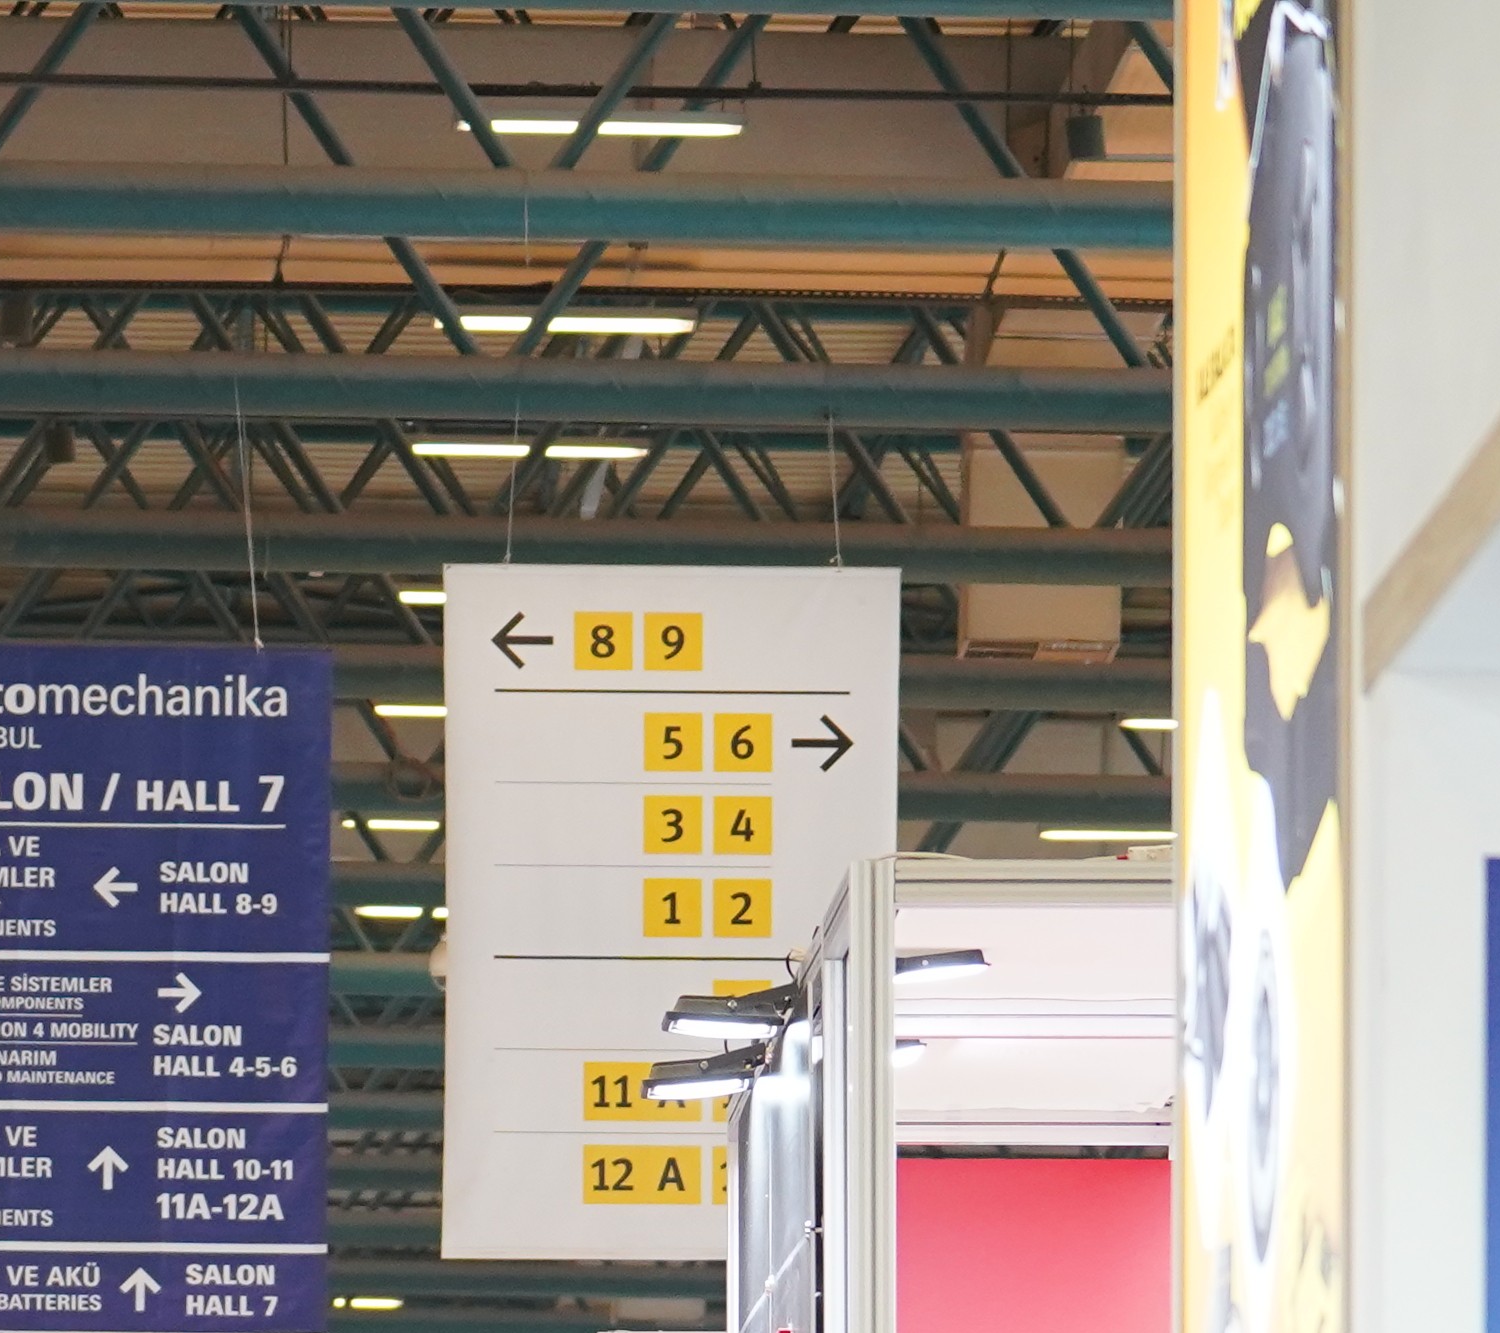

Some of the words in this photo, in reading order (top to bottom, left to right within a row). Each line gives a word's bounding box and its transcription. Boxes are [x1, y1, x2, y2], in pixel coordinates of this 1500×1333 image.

[591, 626, 614, 658] 8
[662, 626, 684, 659] 9
[664, 727, 682, 759] 5
[731, 726, 753, 759] 6
[101, 773, 120, 811] /
[137, 780, 240, 812] HALL
[259, 776, 284, 812] 7
[662, 809, 683, 842] 3
[731, 810, 753, 841] 4
[9, 836, 40, 857] VE
[160, 862, 248, 883] SALON
[161, 893, 227, 914] HALL
[236, 894, 277, 914] 8-9
[663, 893, 680, 924] 1
[732, 893, 752, 924] 2
[11, 973, 112, 992] SİSTEMLER
[33, 1022, 44, 1037] 4
[51, 1023, 138, 1038] MOBILITY
[154, 1024, 241, 1046] SALON
[7, 1071, 114, 1084] MAINTENANCE
[154, 1056, 220, 1077] HALL
[229, 1057, 297, 1077] 4-5-6
[593, 1076, 631, 1107] 11
[5, 1126, 36, 1147] VE
[157, 1127, 245, 1149] SALON
[158, 1158, 224, 1180] HALL
[233, 1159, 293, 1180] 10-11
[592, 1159, 633, 1190] 12
[658, 1158, 684, 1191] A
[157, 1193, 284, 1220] 11A-12A
[7, 1266, 38, 1286] VE
[46, 1262, 100, 1287] AKÜ
[186, 1264, 275, 1285] SALON
[186, 1295, 254, 1316] HALL
[263, 1296, 278, 1316] 7
